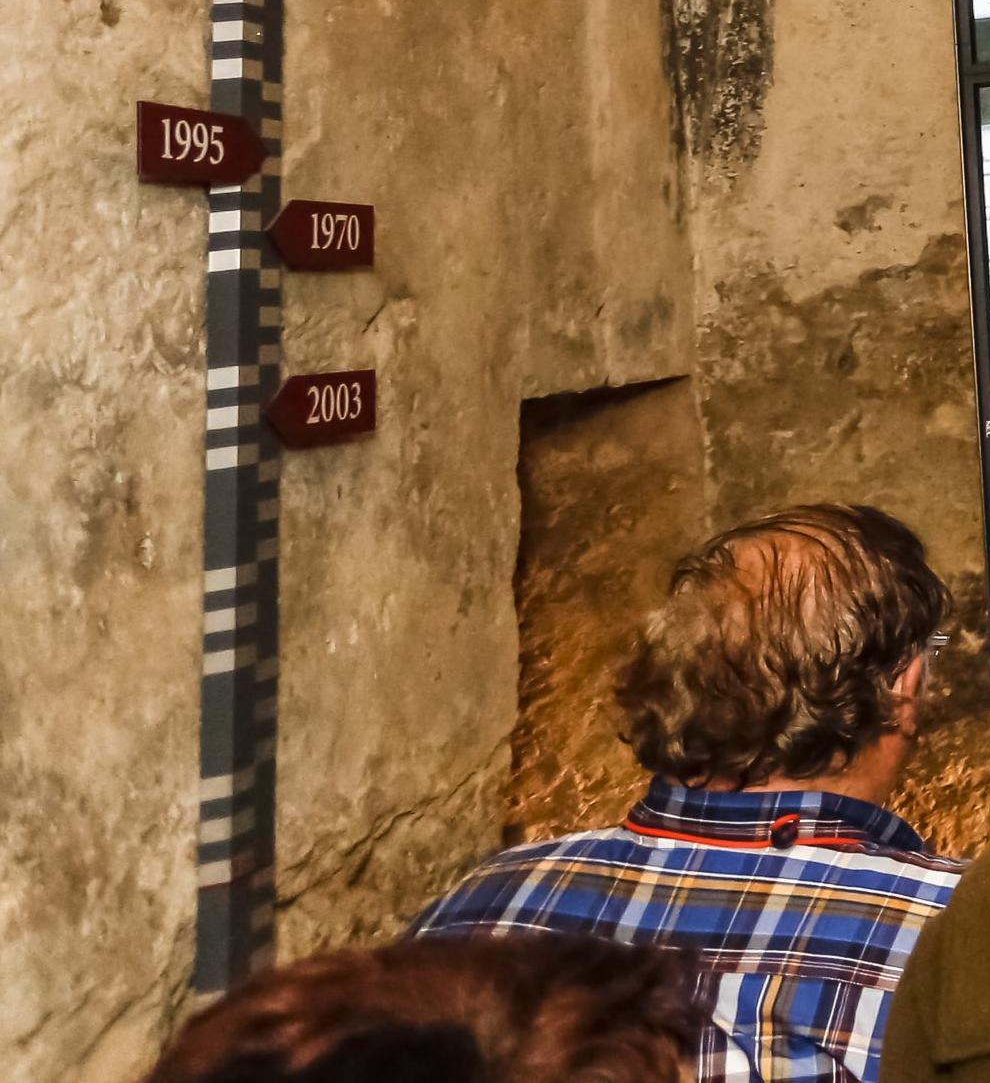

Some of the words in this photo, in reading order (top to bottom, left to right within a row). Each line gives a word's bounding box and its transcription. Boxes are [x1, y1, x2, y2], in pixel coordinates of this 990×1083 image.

[161, 118, 225, 165] 1995
[310, 213, 360, 251] 1970
[306, 382, 362, 424] 2003
